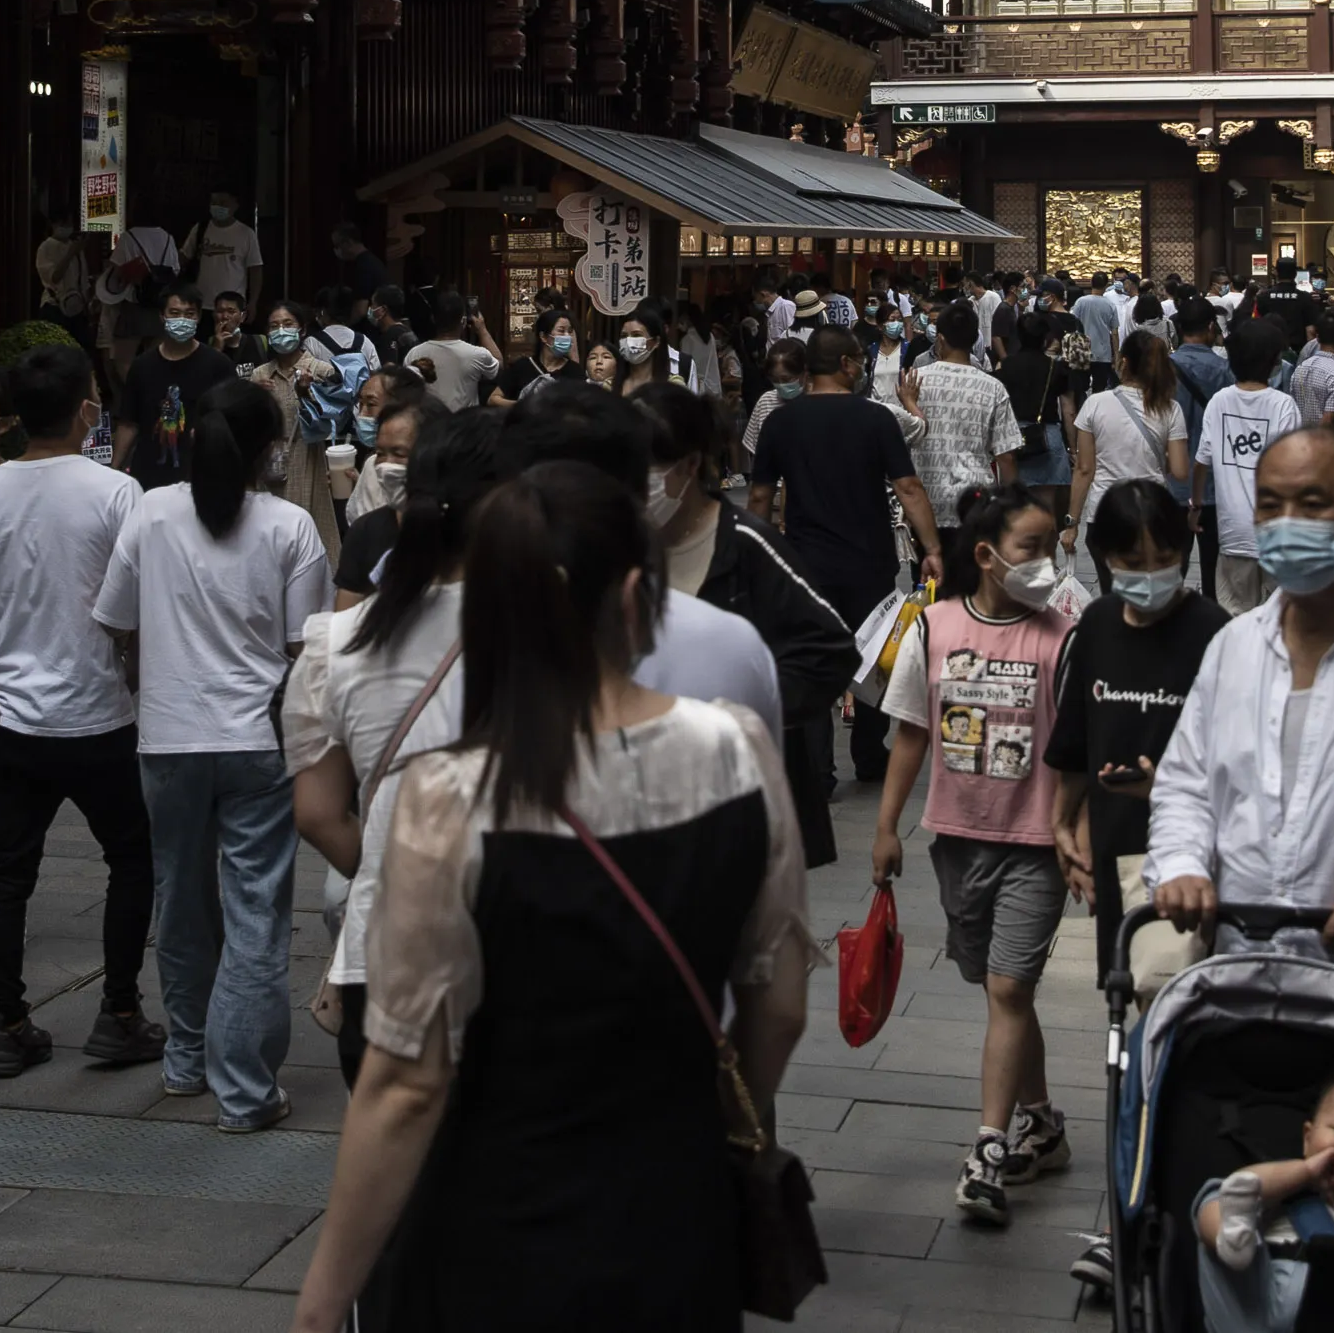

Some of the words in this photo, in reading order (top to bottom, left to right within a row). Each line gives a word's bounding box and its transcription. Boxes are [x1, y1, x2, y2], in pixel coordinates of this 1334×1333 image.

[593, 197, 624, 259] 打卡
[620, 236, 646, 297] 第一站
[956, 687, 984, 699] Sassy
[986, 688, 1009, 701] Style
